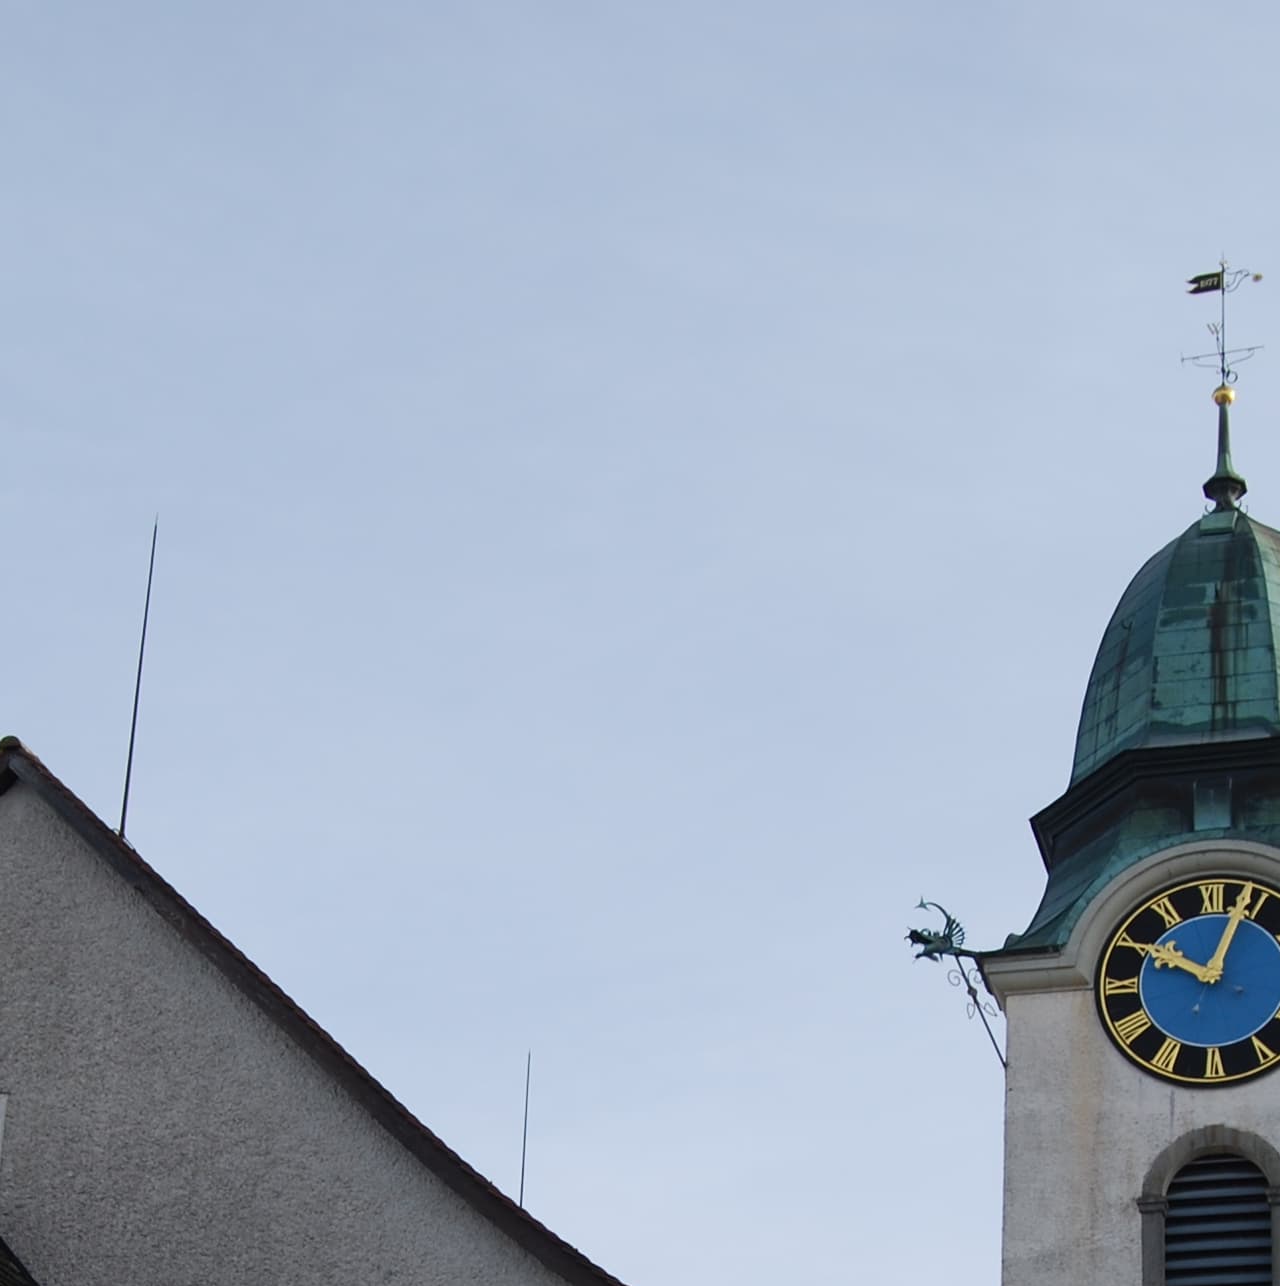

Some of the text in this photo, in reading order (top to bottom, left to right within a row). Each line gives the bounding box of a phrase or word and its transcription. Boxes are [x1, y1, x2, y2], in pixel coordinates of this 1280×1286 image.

[1150, 896, 1183, 929] XI
[1199, 884, 1225, 914] XII
[1251, 891, 1270, 920] I
[1116, 931, 1149, 957] X
[1105, 975, 1138, 996] IX
[1114, 1008, 1152, 1045] VIII
[1150, 1037, 1182, 1073] VII
[1203, 1047, 1226, 1078] VI
[1251, 1034, 1277, 1065] V
